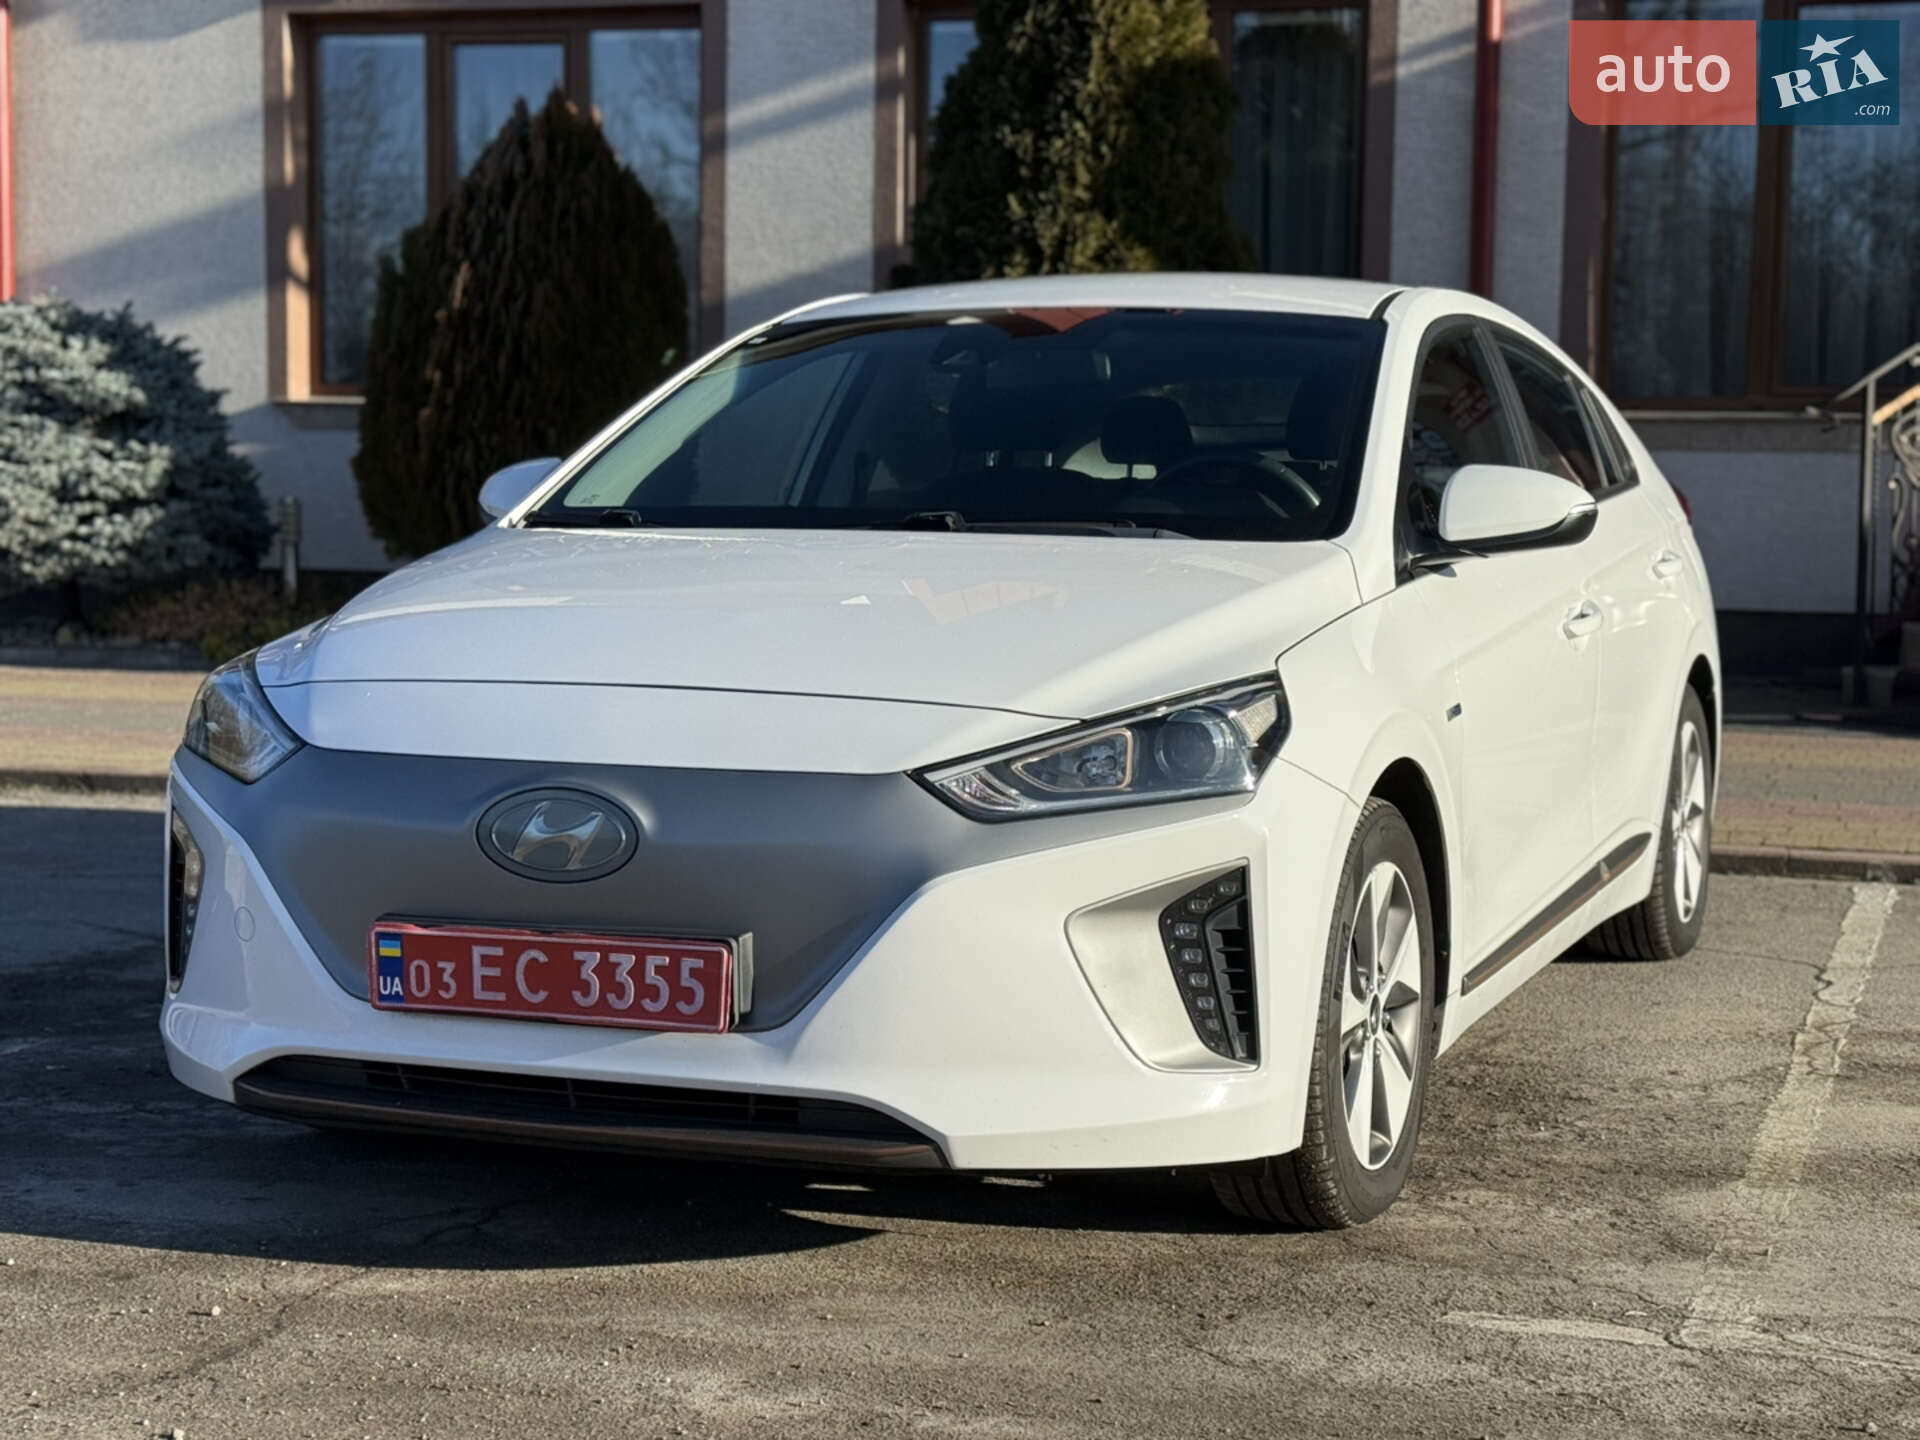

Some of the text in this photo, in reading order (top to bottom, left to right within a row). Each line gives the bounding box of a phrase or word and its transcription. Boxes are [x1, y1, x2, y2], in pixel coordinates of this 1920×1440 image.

[379, 975, 403, 997] UA
[409, 945, 705, 1016] 03 EC 3355
